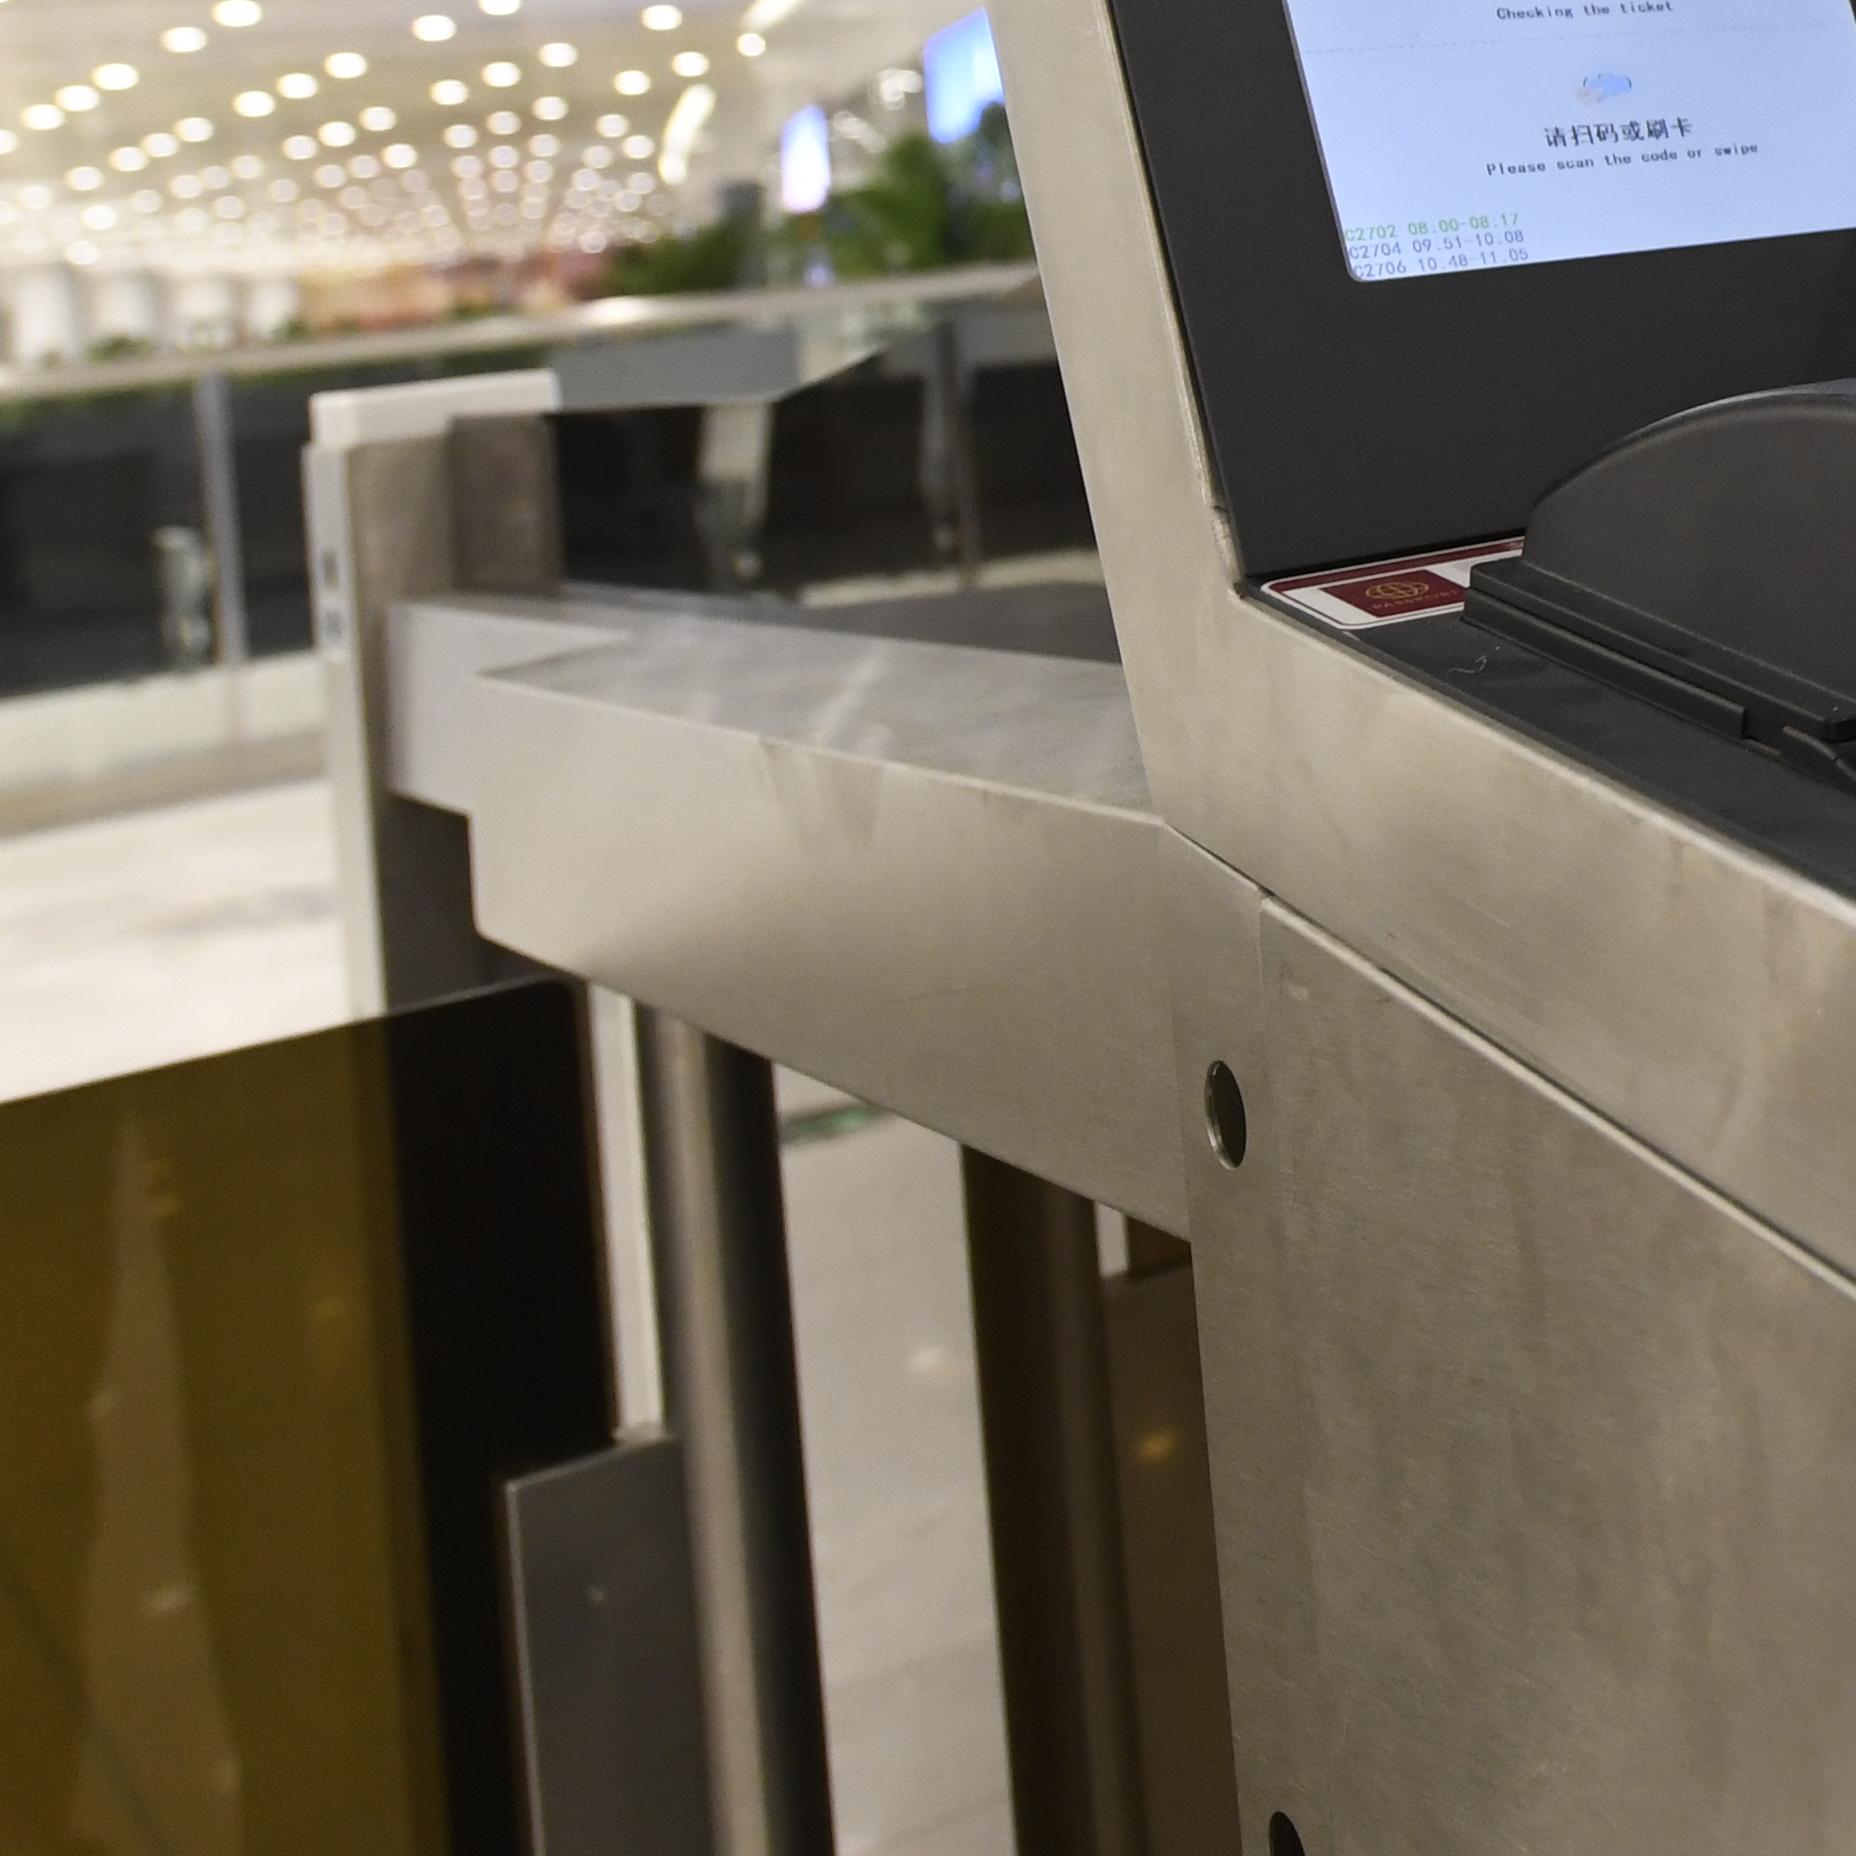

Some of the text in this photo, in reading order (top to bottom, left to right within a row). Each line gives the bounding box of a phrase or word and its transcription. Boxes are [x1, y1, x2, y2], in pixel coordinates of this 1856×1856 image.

[1496, 1, 1674, 20] Checking the ticket
[1543, 117, 1693, 148] 请扫码或刷卡
[1486, 143, 1759, 176] Please scan the code or swipe
[1344, 224, 1398, 242] C2702
[1349, 241, 1402, 260] C2704
